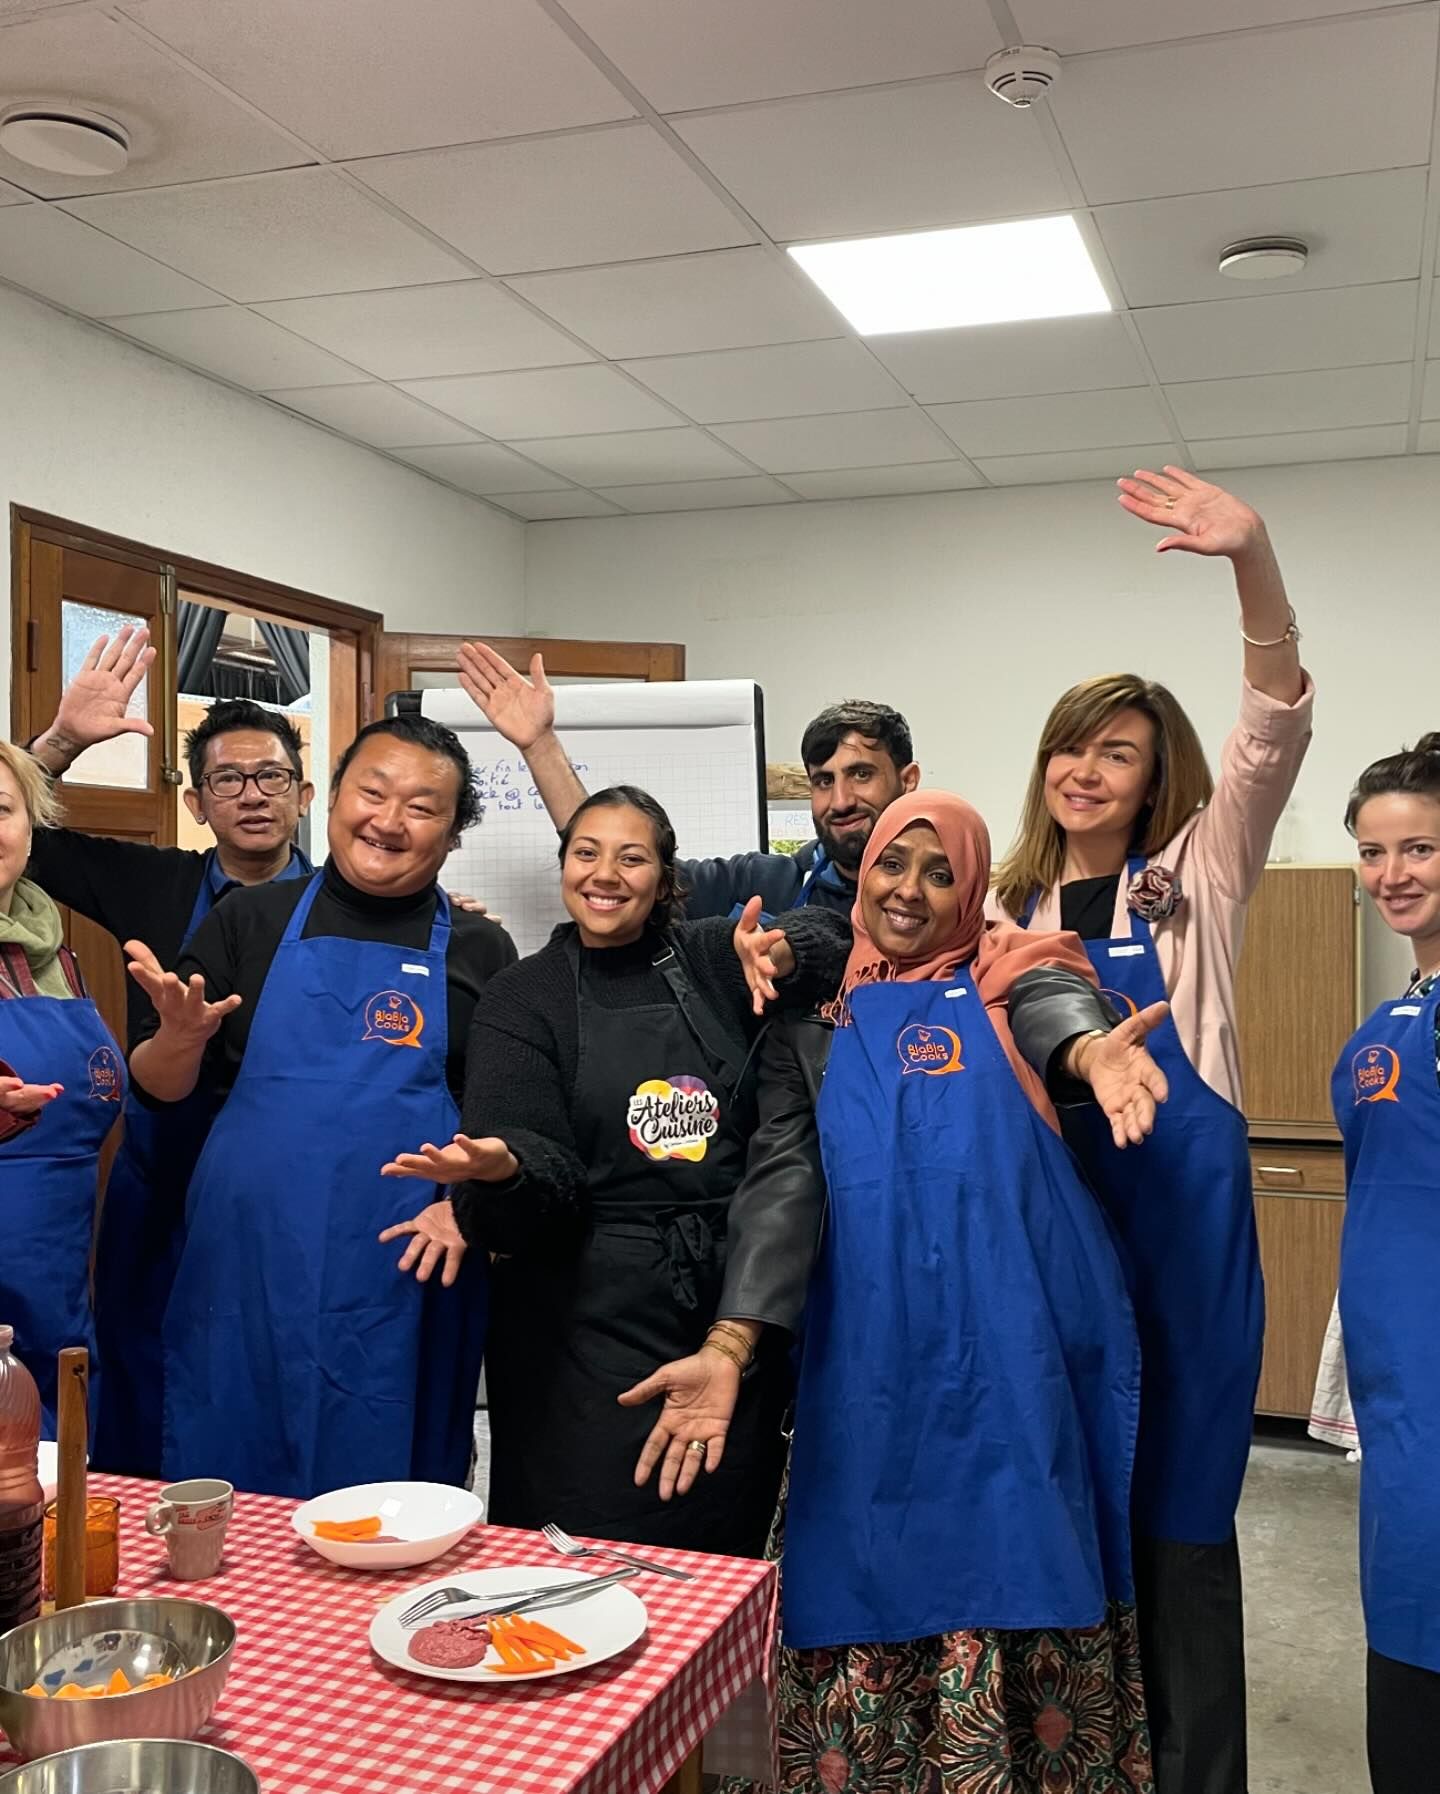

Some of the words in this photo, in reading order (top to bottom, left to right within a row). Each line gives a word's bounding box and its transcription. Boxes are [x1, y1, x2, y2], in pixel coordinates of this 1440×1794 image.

[375, 1009, 409, 1024] BlaBla
[374, 1020, 410, 1033] Cooks
[907, 1042, 945, 1056] BlaBla
[909, 1052, 949, 1063] Cooks
[630, 1091, 714, 1126] Ateliers
[640, 1115, 714, 1145] Cuisine
